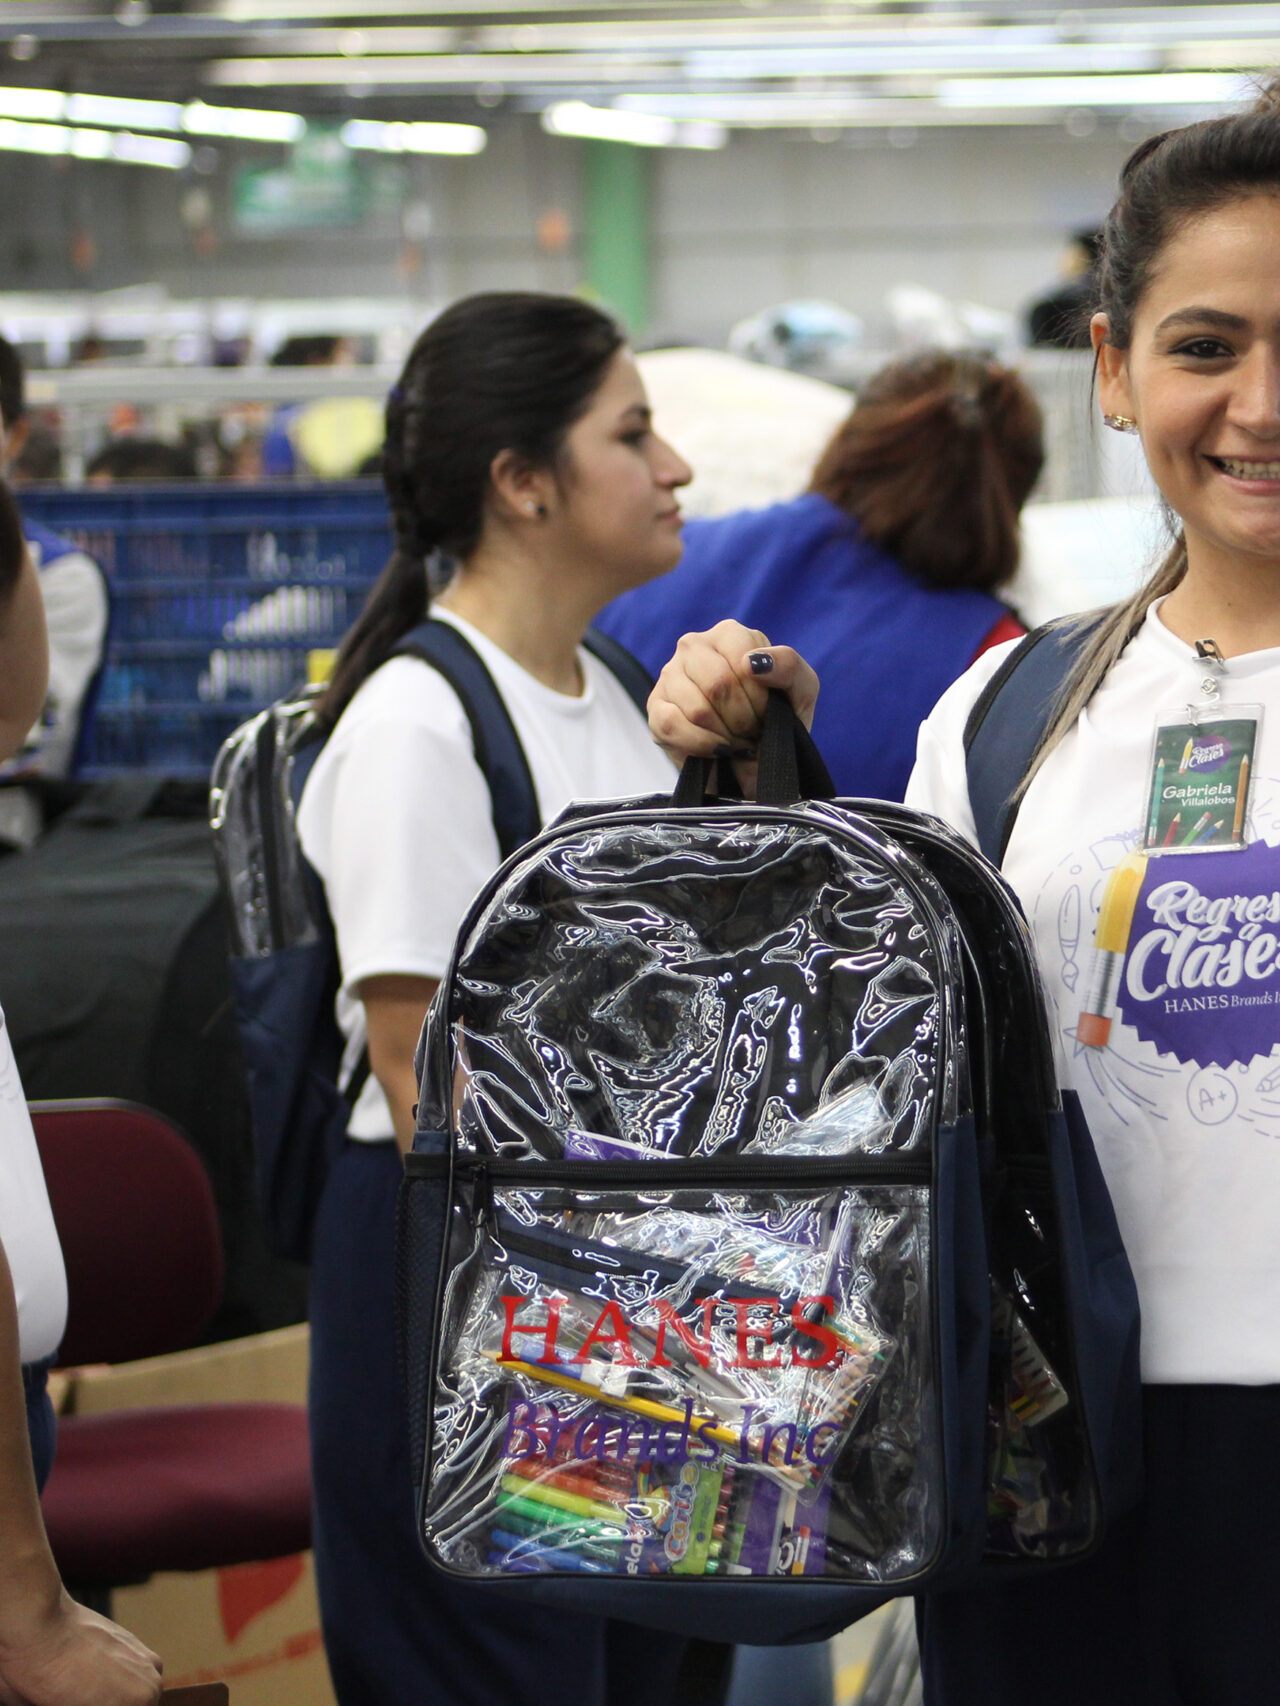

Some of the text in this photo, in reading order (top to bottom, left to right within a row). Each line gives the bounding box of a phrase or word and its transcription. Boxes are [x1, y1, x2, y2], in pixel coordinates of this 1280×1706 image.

[1188, 748, 1225, 768] Clases
[1163, 783, 1233, 799] Gabriela
[1181, 795, 1236, 807] Villalobos
[1238, 922, 1263, 942] a
[1164, 994, 1229, 1014] HANES
[1231, 990, 1273, 1008] Brands
[496, 1295, 843, 1368] HANES
[499, 1399, 721, 1465] Brands
[738, 1404, 844, 1466] Inc
